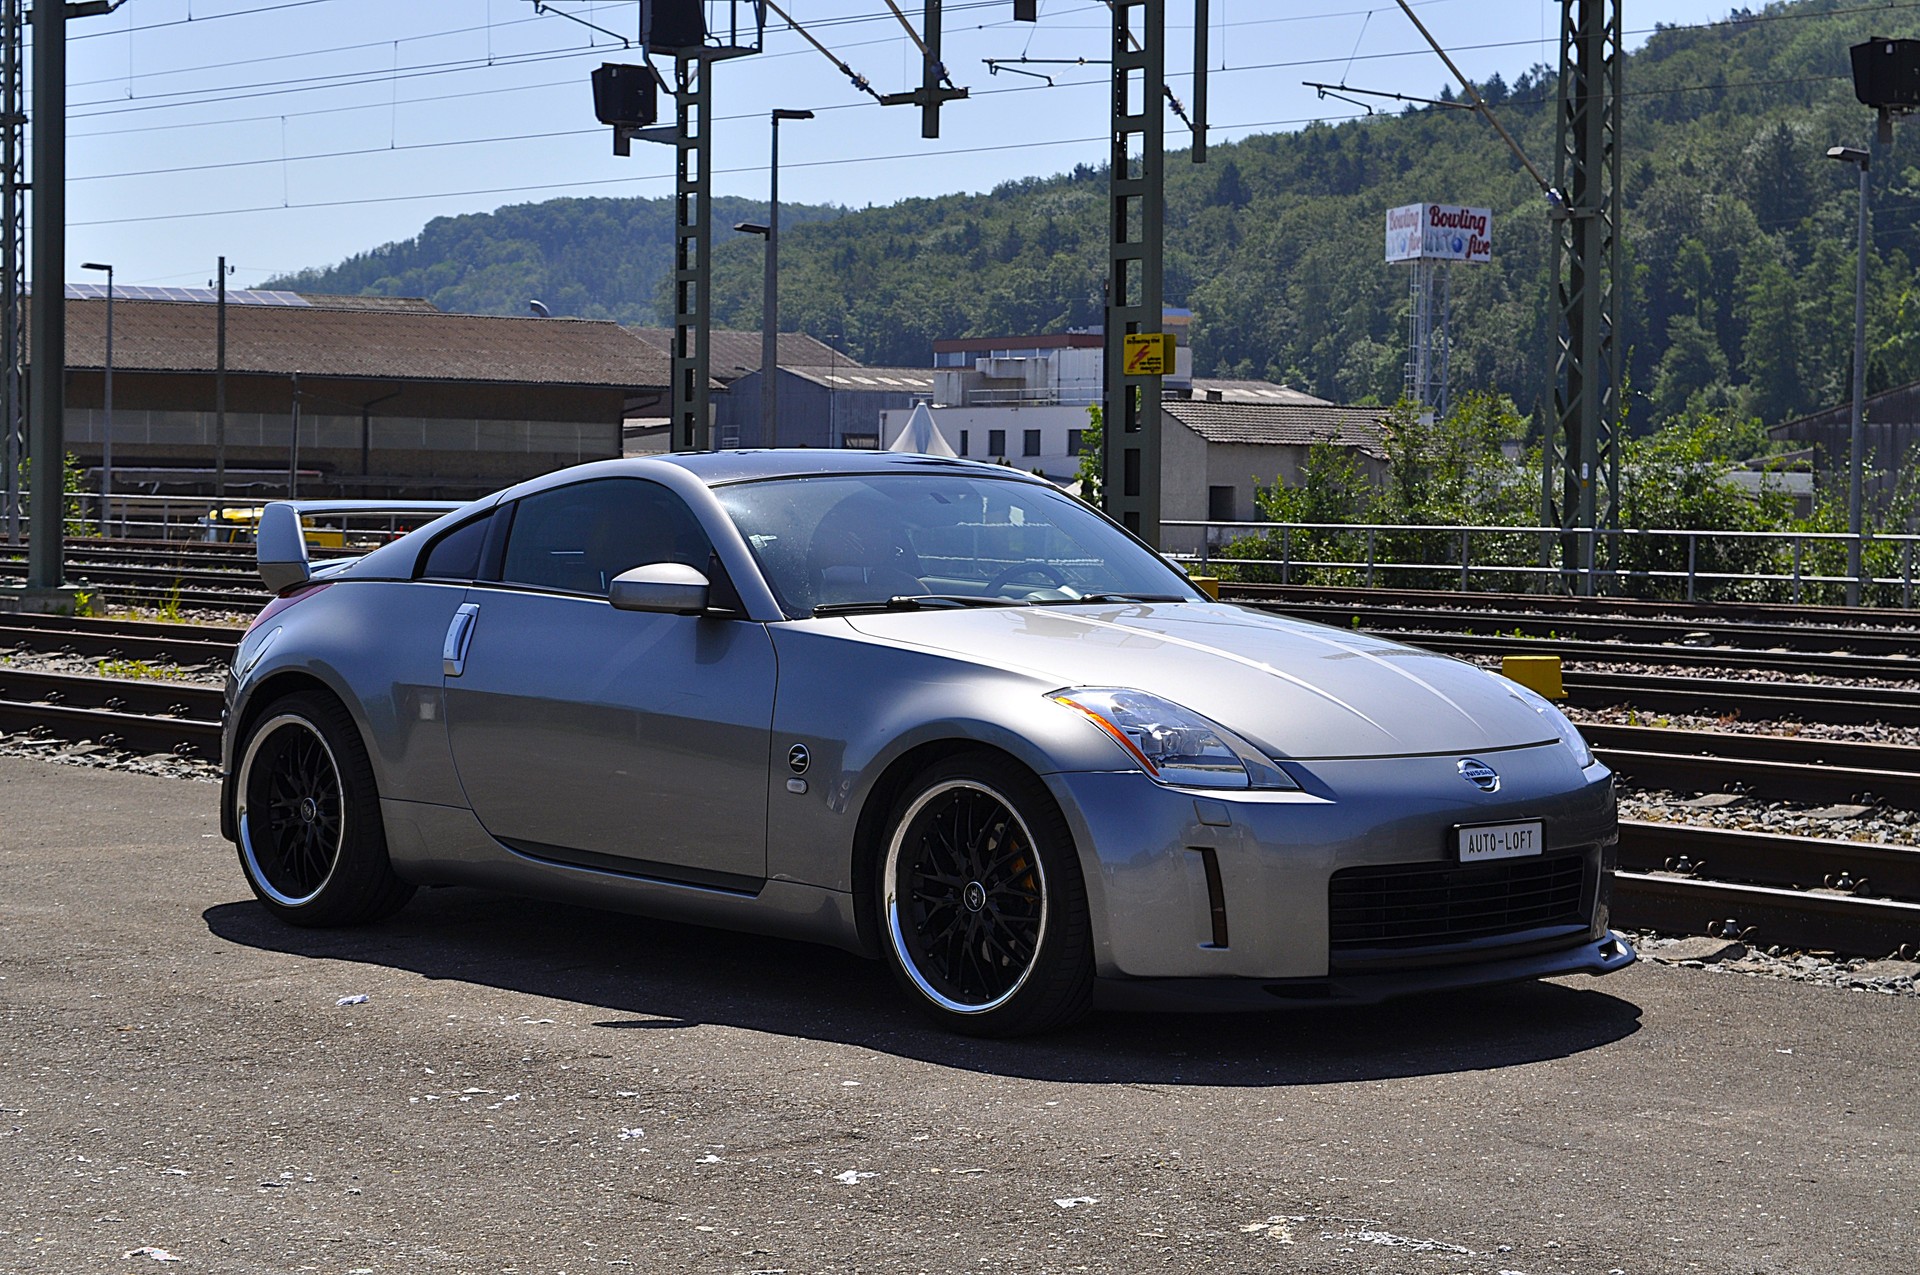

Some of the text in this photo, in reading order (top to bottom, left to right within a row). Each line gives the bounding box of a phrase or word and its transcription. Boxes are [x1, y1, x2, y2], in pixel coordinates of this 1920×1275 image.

[1389, 208, 1419, 232] Bowling
[1429, 205, 1487, 237] Bowling
[1465, 234, 1490, 258] five
[790, 752, 806, 766] Z
[1466, 769, 1494, 777] NISSAN
[1468, 830, 1533, 854] AUTO-LOFT
